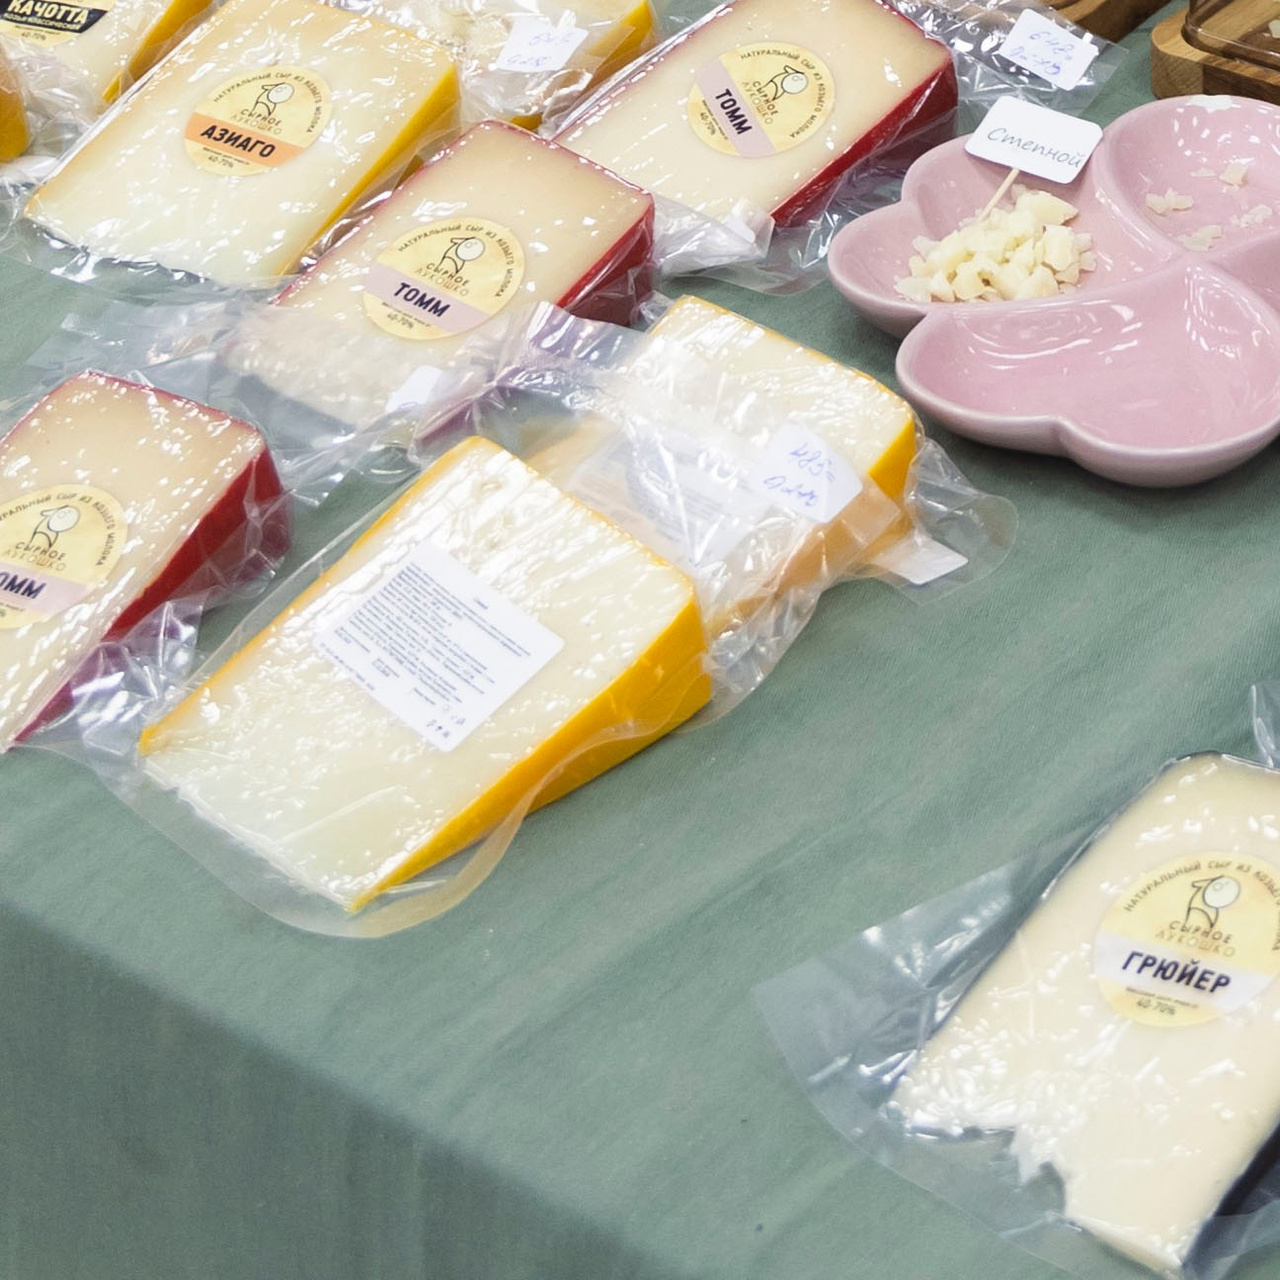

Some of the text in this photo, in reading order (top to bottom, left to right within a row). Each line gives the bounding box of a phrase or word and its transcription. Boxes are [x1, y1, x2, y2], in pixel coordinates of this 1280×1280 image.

[715, 88, 752, 135] ТОММ
[200, 125, 276, 158] АЗИАГО
[987, 127, 1085, 168] Степной
[393, 282, 451, 317] ТОММ
[1124, 861, 1201, 912] НАТУРАЛЬНЫЙ
[1208, 861, 1231, 869] СЫР
[1236, 864, 1251, 874] ИЗ
[1155, 929, 1235, 957] ЛУКОШКО
[1169, 921, 1232, 944] СЫРНОЕ
[1122, 951, 1231, 993] ГРЮЙЕР
